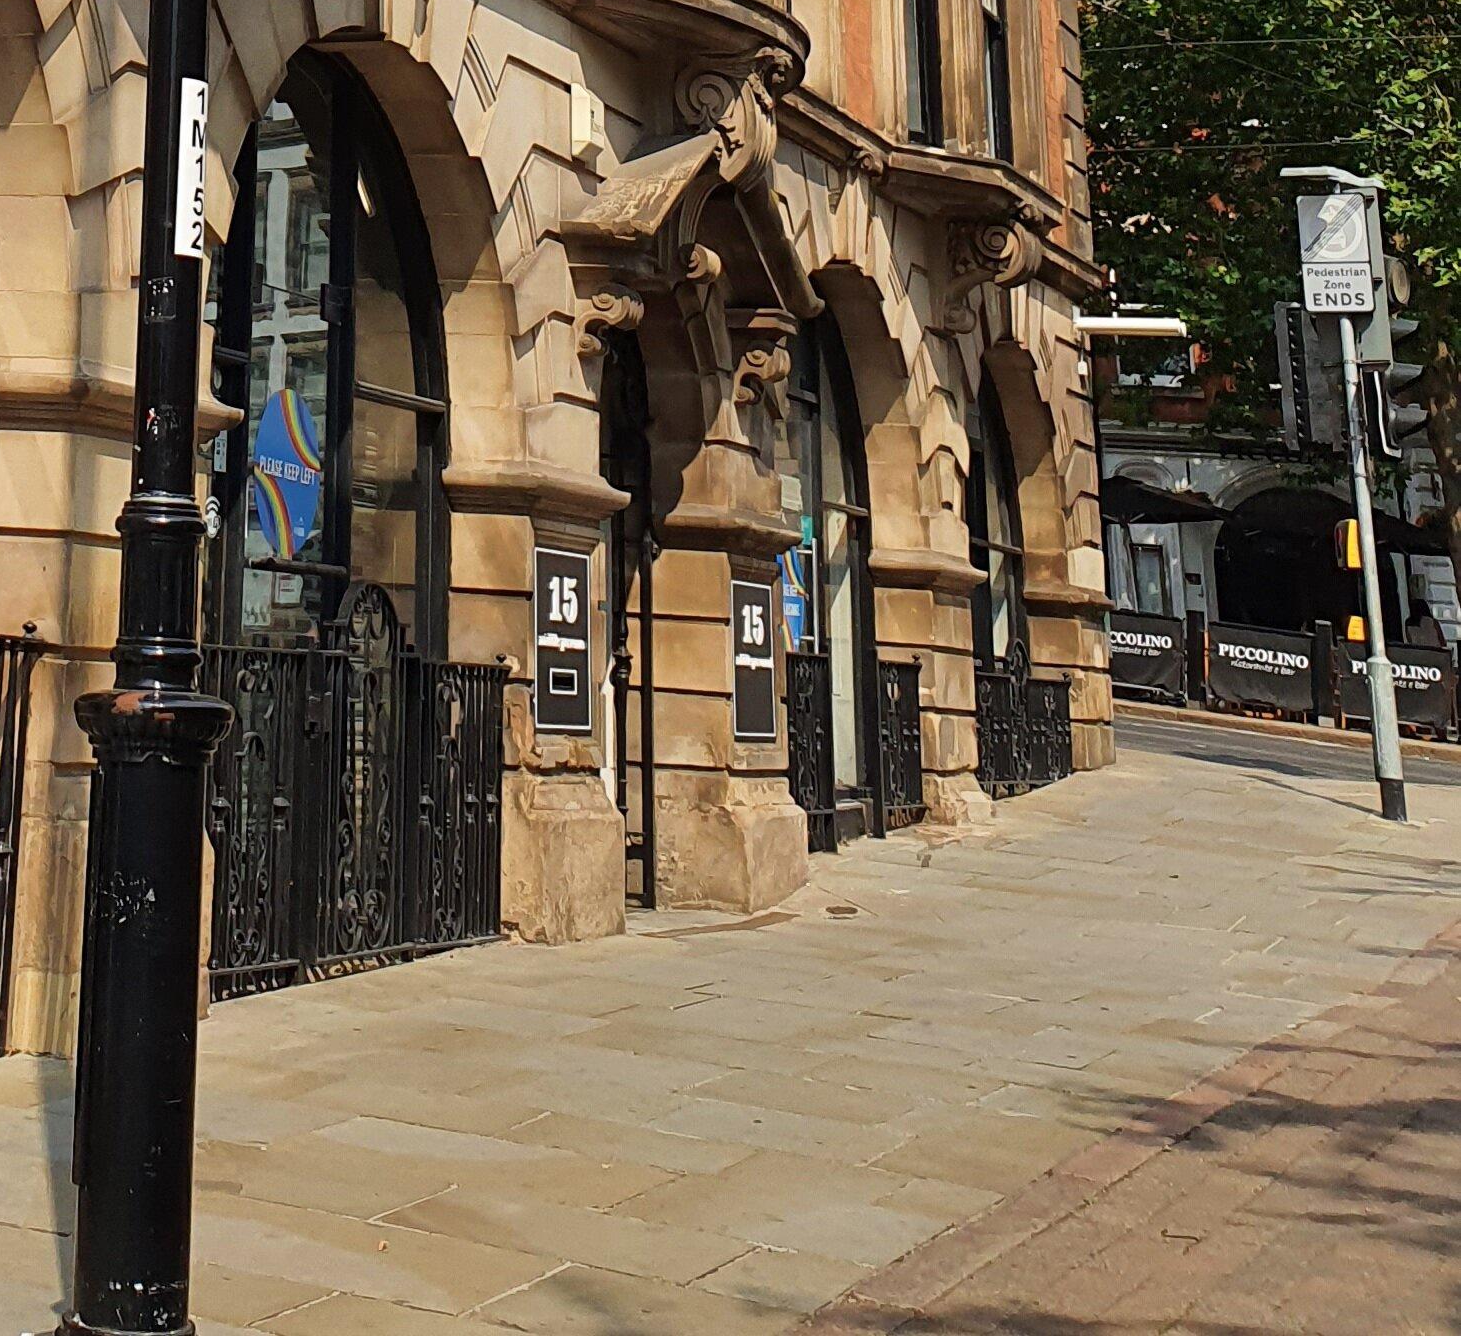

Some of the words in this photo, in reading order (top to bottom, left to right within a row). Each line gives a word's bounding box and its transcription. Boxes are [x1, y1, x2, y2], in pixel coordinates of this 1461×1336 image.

[1307, 267, 1367, 277] Pedestrian
[1323, 279, 1351, 290] Zone
[1312, 292, 1365, 307] ENDS
[259, 455, 283, 478] PLEASE
[284, 463, 300, 481] KEEP
[300, 467, 316, 486] LEFT
[549, 576, 579, 624] 15
[742, 604, 765, 645] 15
[1110, 630, 1172, 649] CCOLINO
[1218, 642, 1309, 669] PICCOLINO
[1351, 660, 1441, 682] PIOLINO
